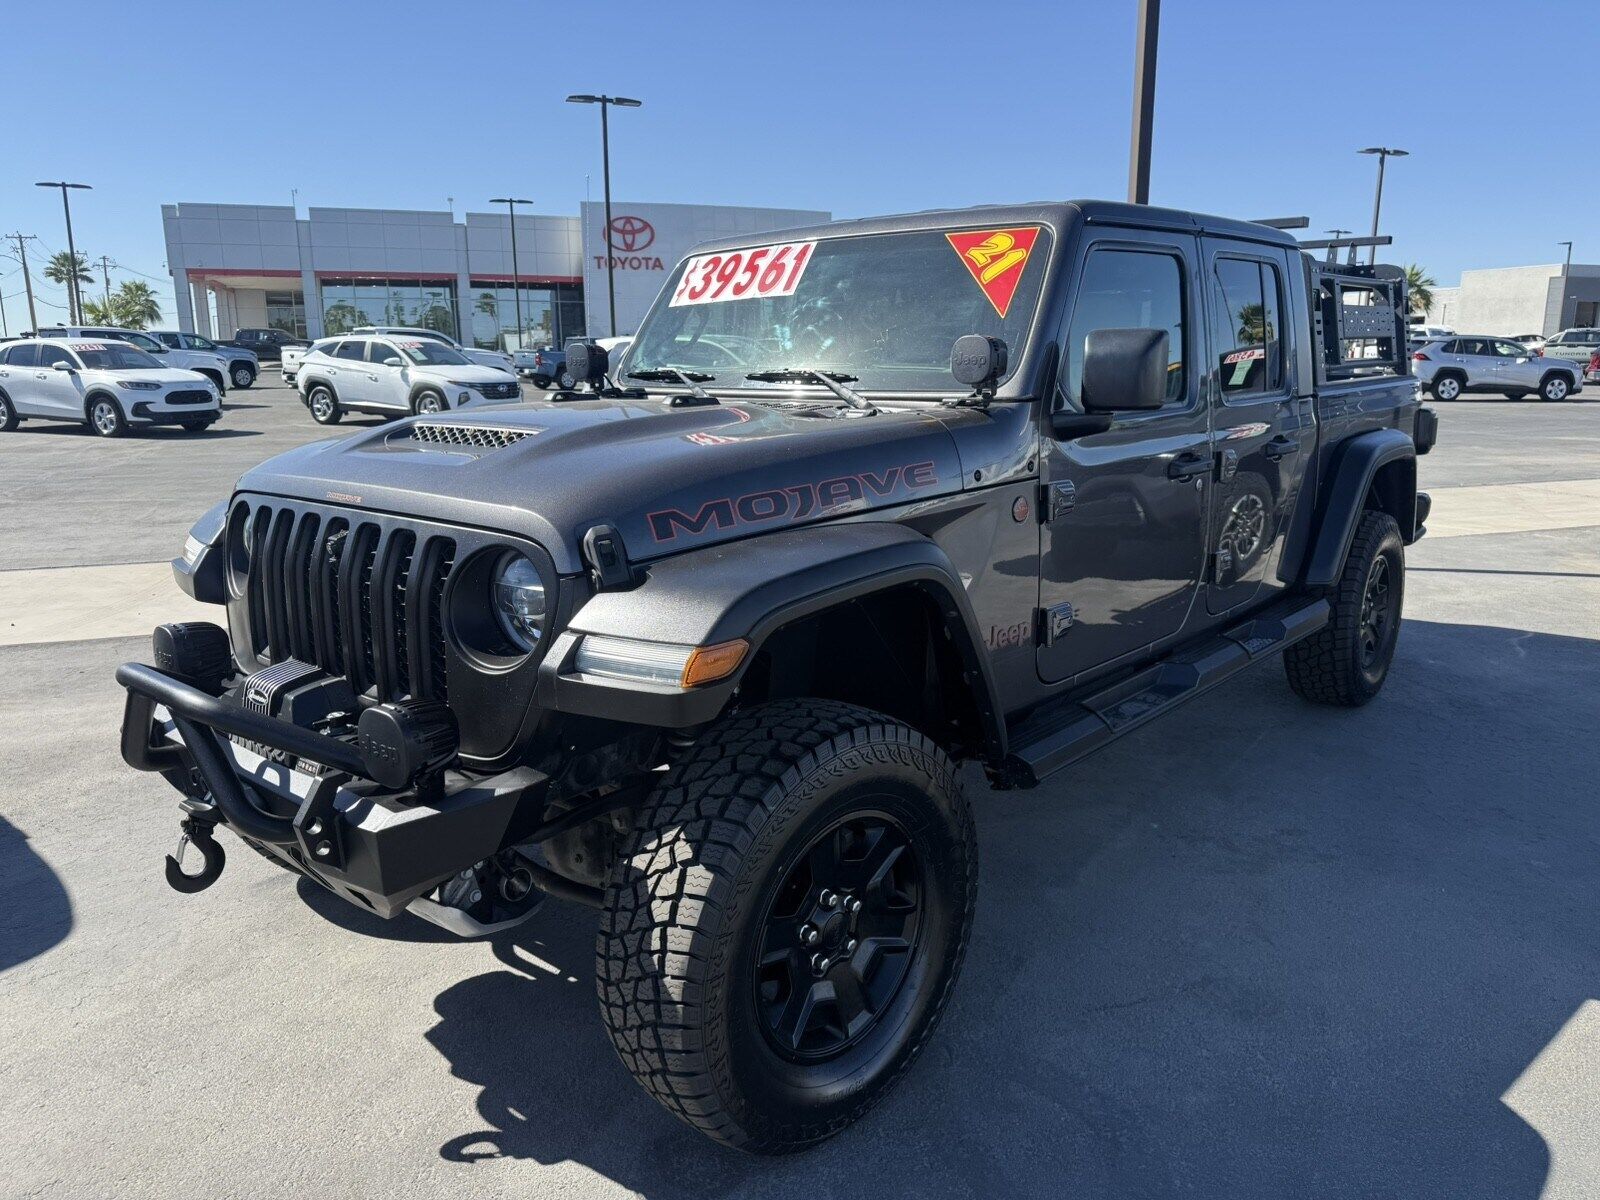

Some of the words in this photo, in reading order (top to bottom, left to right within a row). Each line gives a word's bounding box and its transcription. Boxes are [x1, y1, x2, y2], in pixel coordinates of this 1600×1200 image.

[593, 255, 665, 271] TOYOTA
[965, 232, 1026, 285] 21
[955, 351, 987, 369] Jeep
[647, 461, 938, 542] MOJAVE
[984, 621, 1031, 651] Jeep
[361, 732, 399, 768] Jeep
